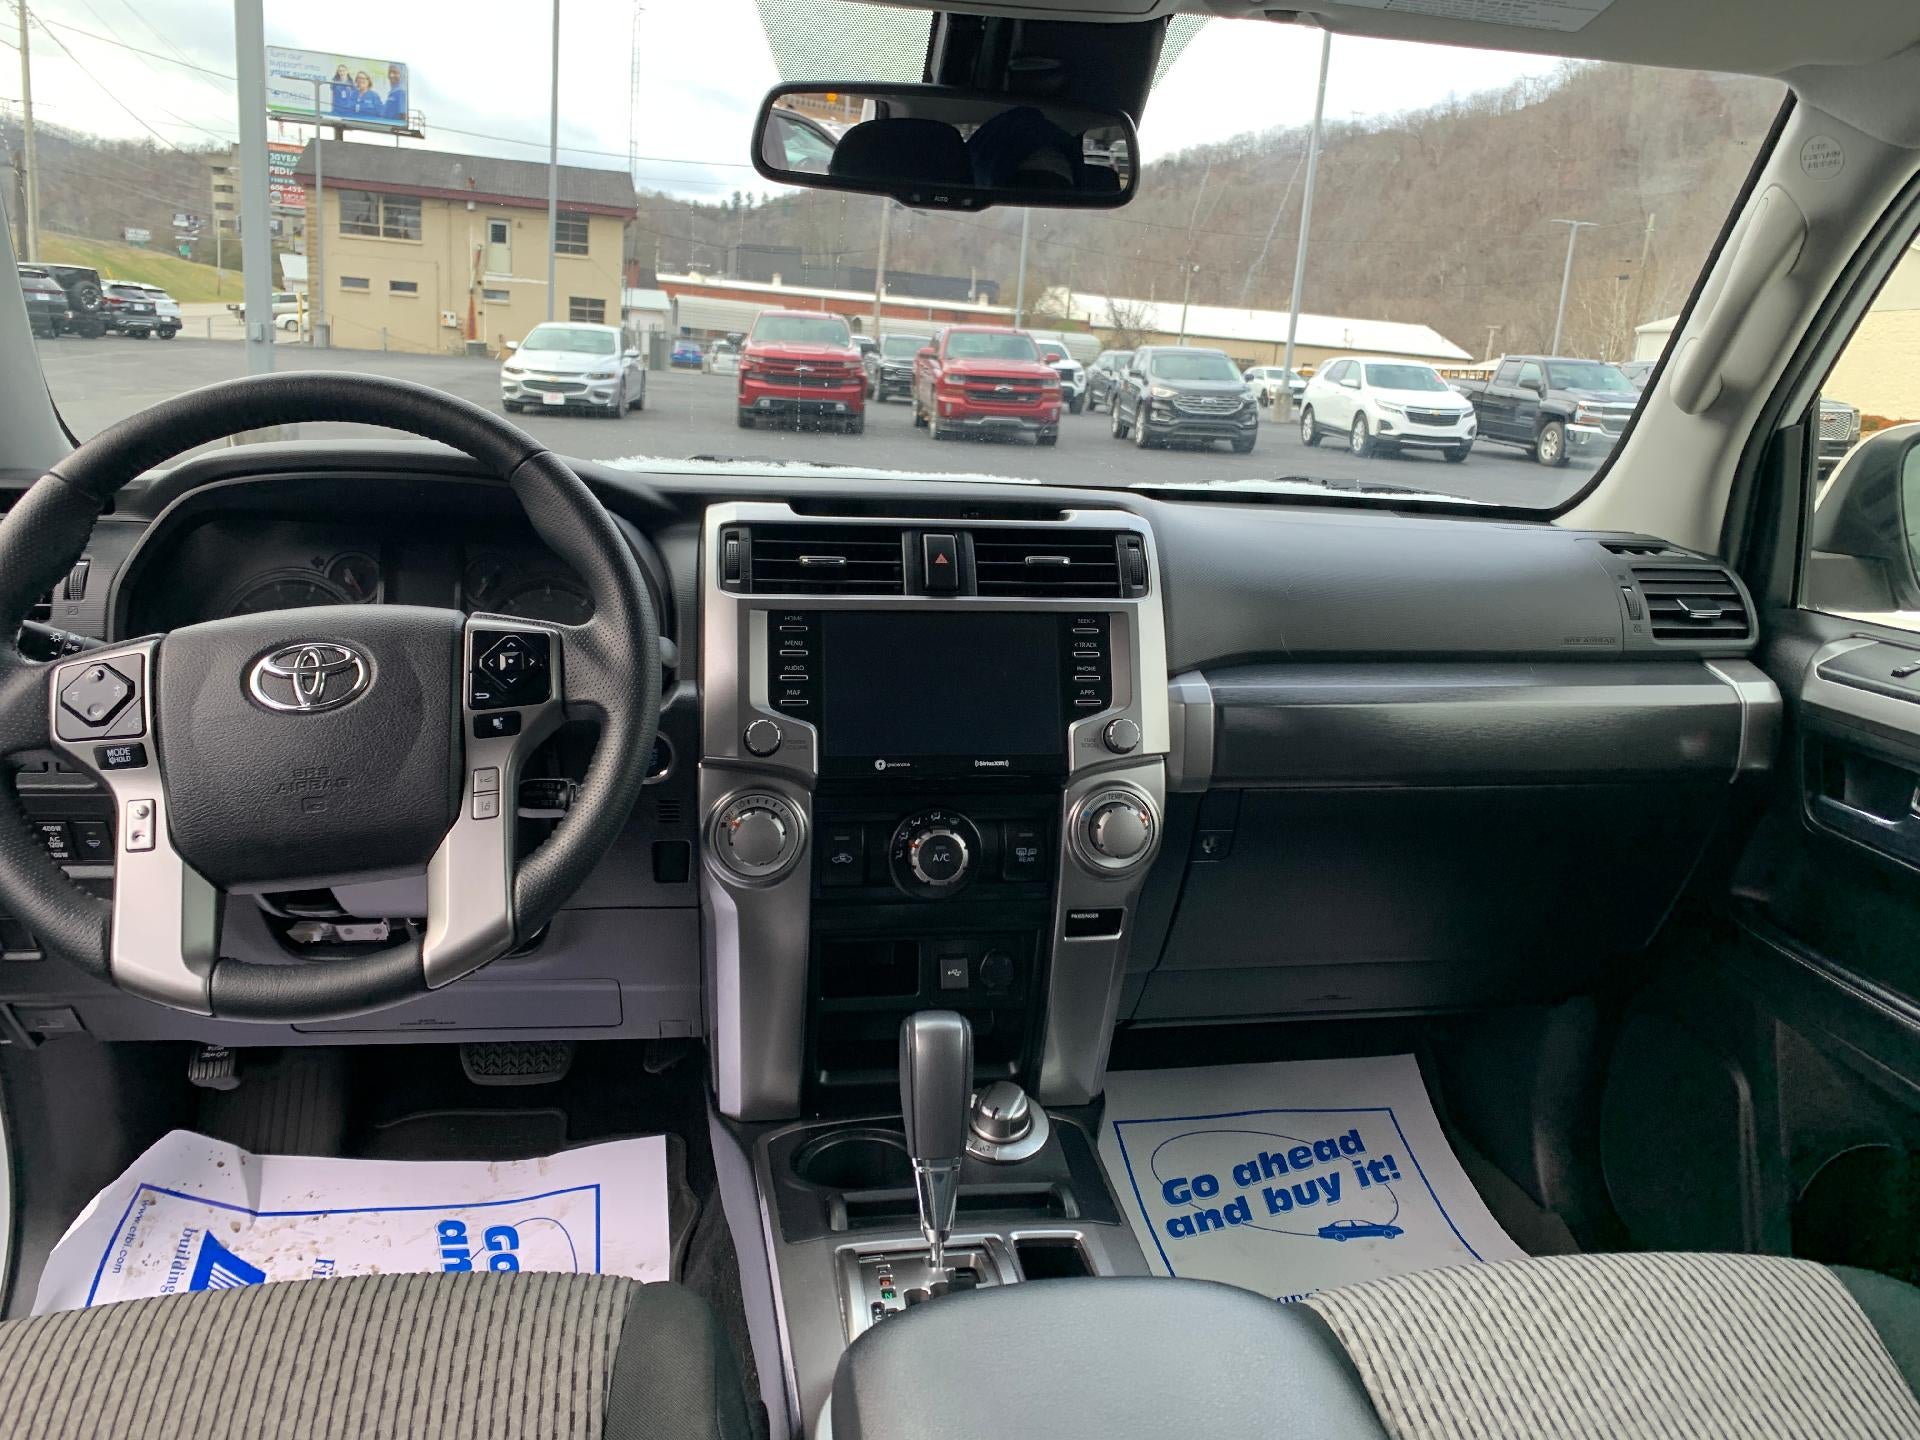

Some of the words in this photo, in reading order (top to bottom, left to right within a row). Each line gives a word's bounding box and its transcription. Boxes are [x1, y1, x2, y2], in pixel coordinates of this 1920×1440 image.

[106, 747, 131, 757] MODE
[932, 853, 950, 862] A/C
[1161, 1173, 1221, 1208] Go
[1231, 1128, 1368, 1189] ahead
[1165, 1194, 1254, 1241] and
[1261, 1170, 1342, 1217] buy
[1352, 1153, 1403, 1190] it!
[111, 1199, 151, 1275] www.ctbi.com
[159, 1226, 199, 1293] building
[434, 1219, 473, 1273] an
[884, 1292, 893, 1300] N
